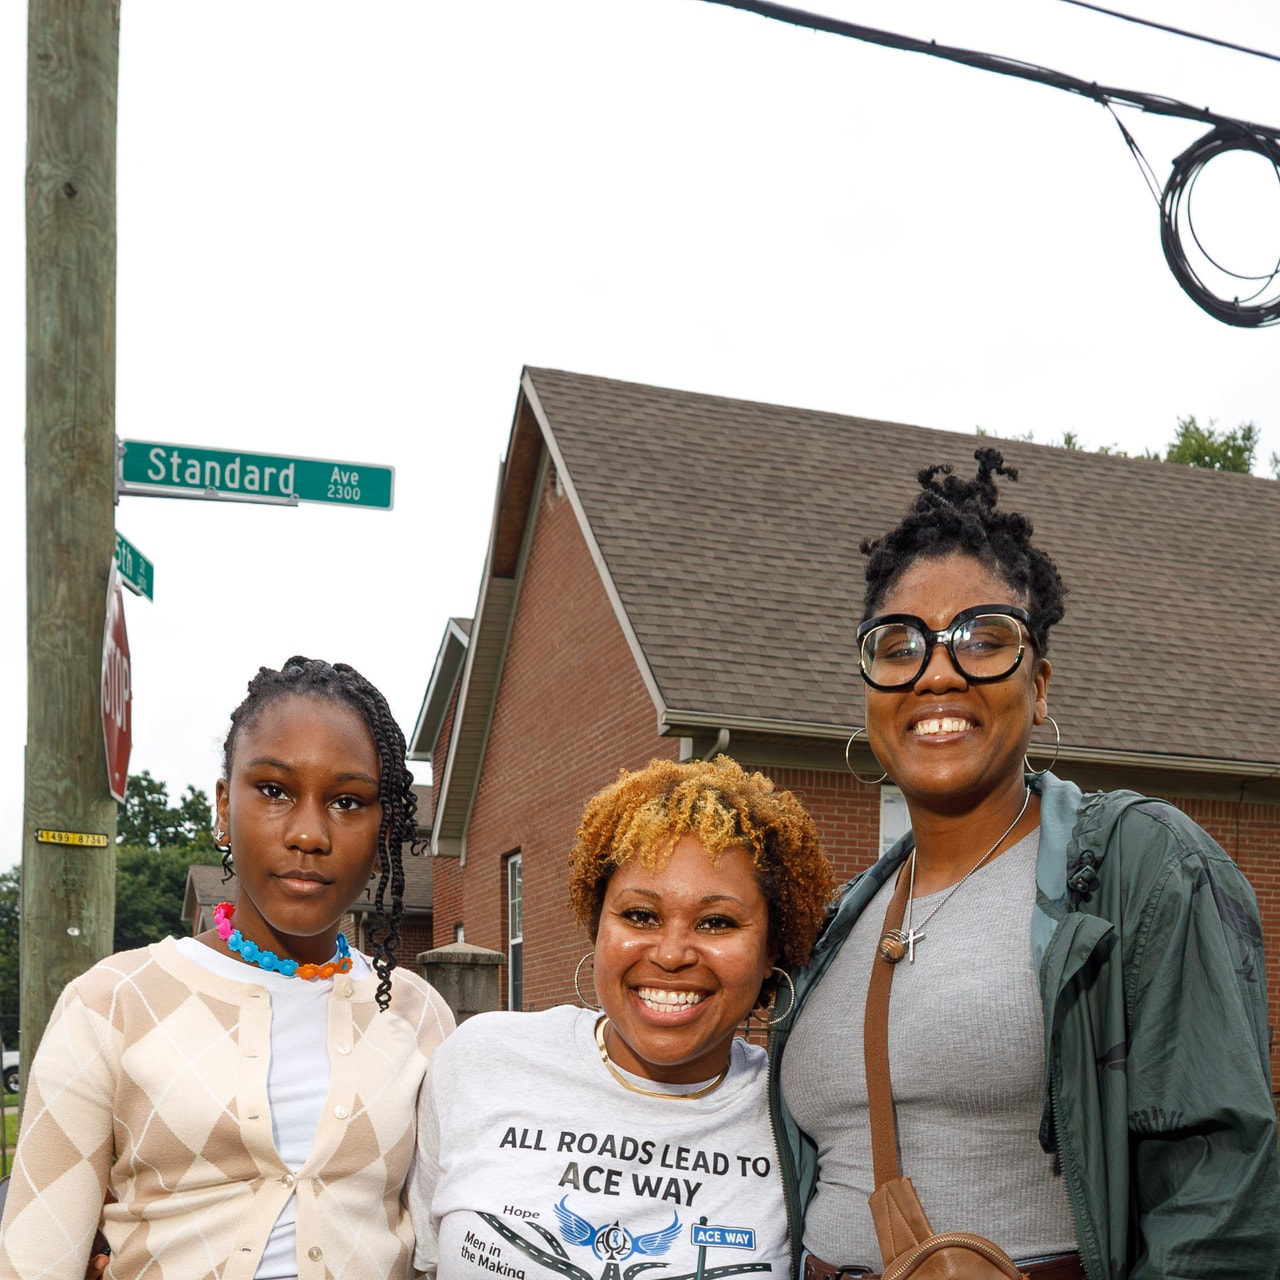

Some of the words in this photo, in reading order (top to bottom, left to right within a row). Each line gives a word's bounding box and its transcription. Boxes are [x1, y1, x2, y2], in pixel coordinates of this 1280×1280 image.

[147, 447, 296, 495] Standard
[330, 466, 360, 486] Ave
[326, 484, 361, 501] 2300
[102, 646, 129, 732] STOP
[499, 1127, 548, 1152] ALL
[557, 1131, 656, 1165] ROADS
[660, 1144, 730, 1176] LEAD
[735, 1155, 771, 1178] TO
[558, 1162, 622, 1196] ACE
[632, 1173, 703, 1208] WAY
[503, 1205, 540, 1219] Hope
[464, 1231, 486, 1252] Men
[489, 1242, 502, 1258] in
[697, 1230, 721, 1243] ACE
[725, 1231, 750, 1245] WAY
[461, 1246, 476, 1263] the
